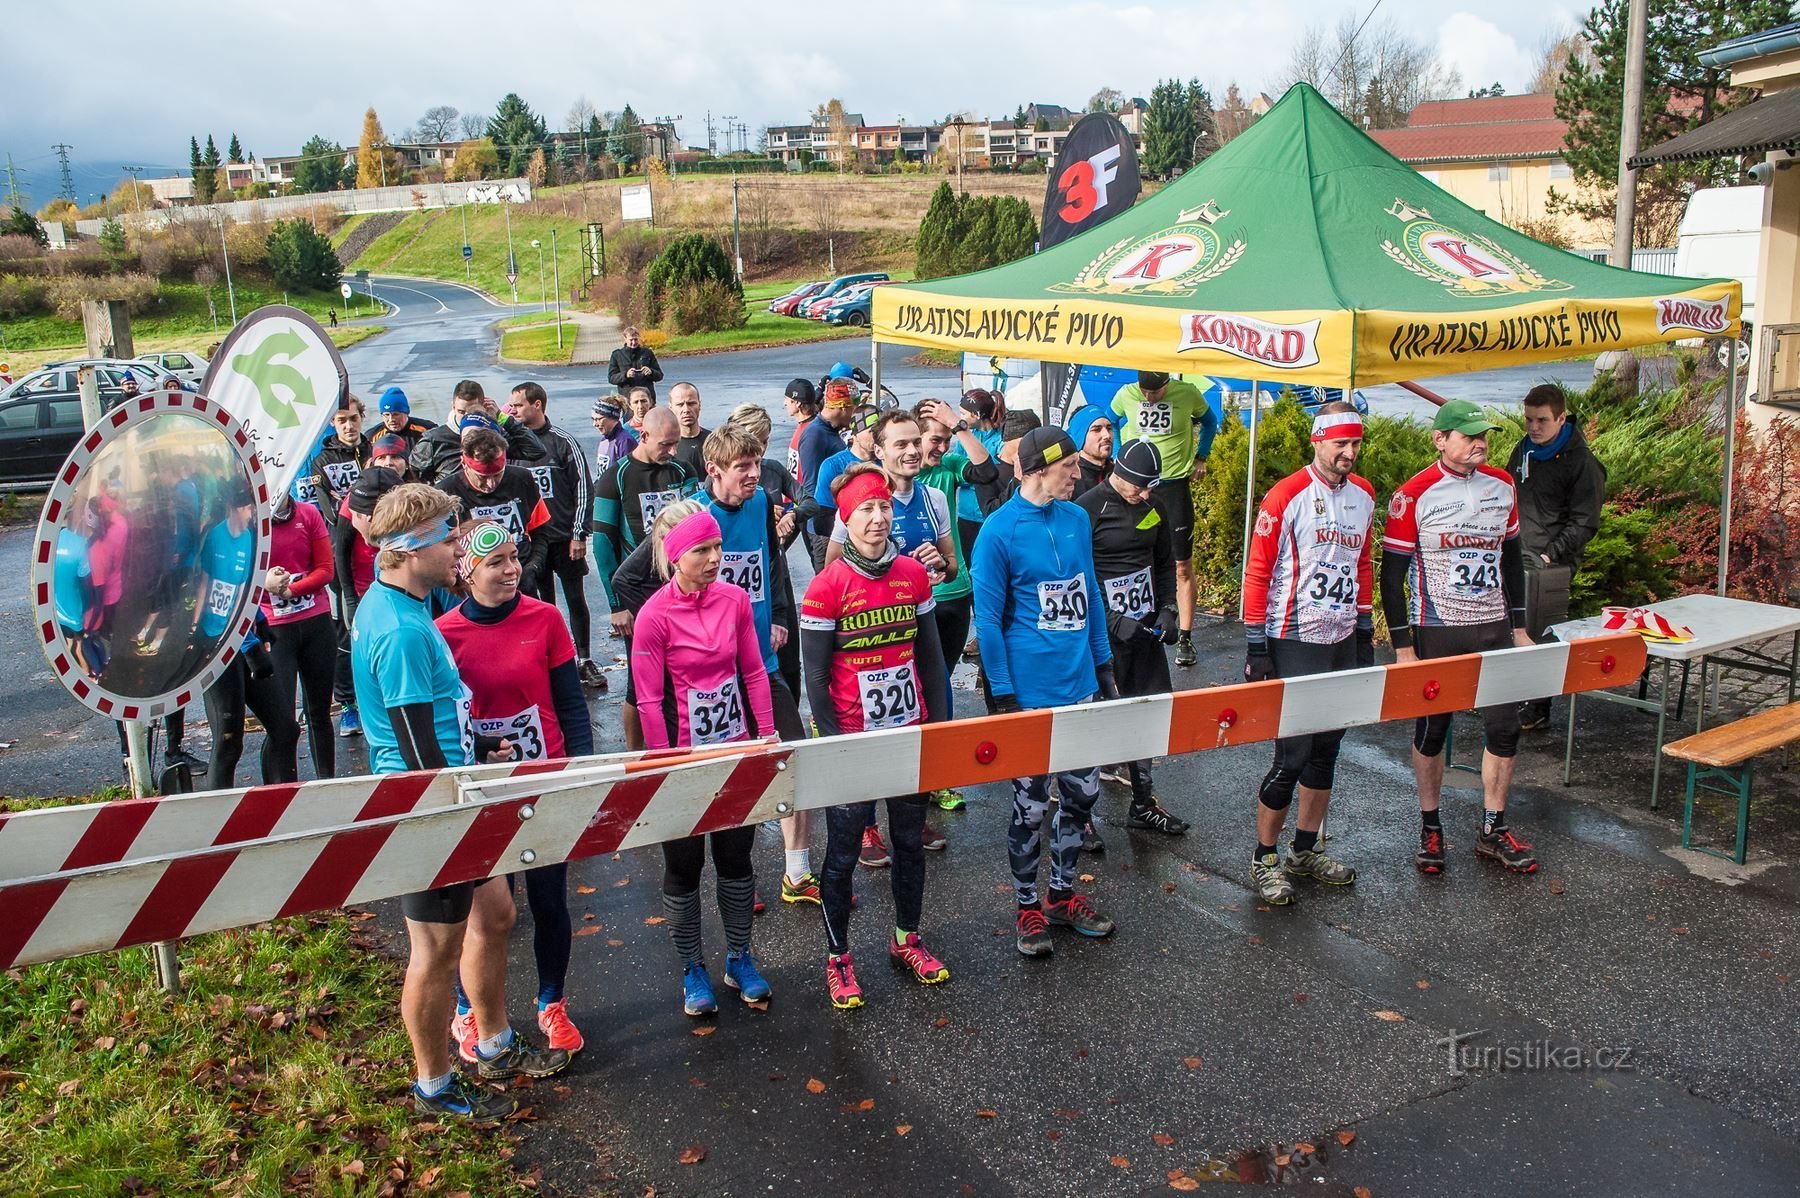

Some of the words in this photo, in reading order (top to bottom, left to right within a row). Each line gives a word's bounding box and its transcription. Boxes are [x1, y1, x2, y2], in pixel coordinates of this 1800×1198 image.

[1058, 143, 1120, 224] 3F
[1111, 243, 1195, 280] K
[1428, 240, 1509, 278] K
[1577, 308, 1622, 344] PIVO
[1659, 299, 1724, 330] KONRAD
[1065, 311, 1124, 350] PIVO
[1190, 314, 1306, 364] KONRAD
[1139, 410, 1171, 429] 325
[723, 554, 743, 562] OZP
[1459, 551, 1479, 559] OZP
[720, 565, 763, 593] 349
[1044, 583, 1064, 592] OZP
[1112, 578, 1130, 588] OZP
[1310, 572, 1355, 604] 342
[1454, 564, 1500, 589] 343
[1042, 591, 1088, 621] 340
[1112, 582, 1153, 615] 364
[852, 655, 883, 665] WTB
[867, 672, 889, 682] OZP
[696, 692, 718, 700] OZP
[866, 679, 917, 720] 320
[480, 721, 505, 731] OZP
[693, 692, 742, 737] 324
